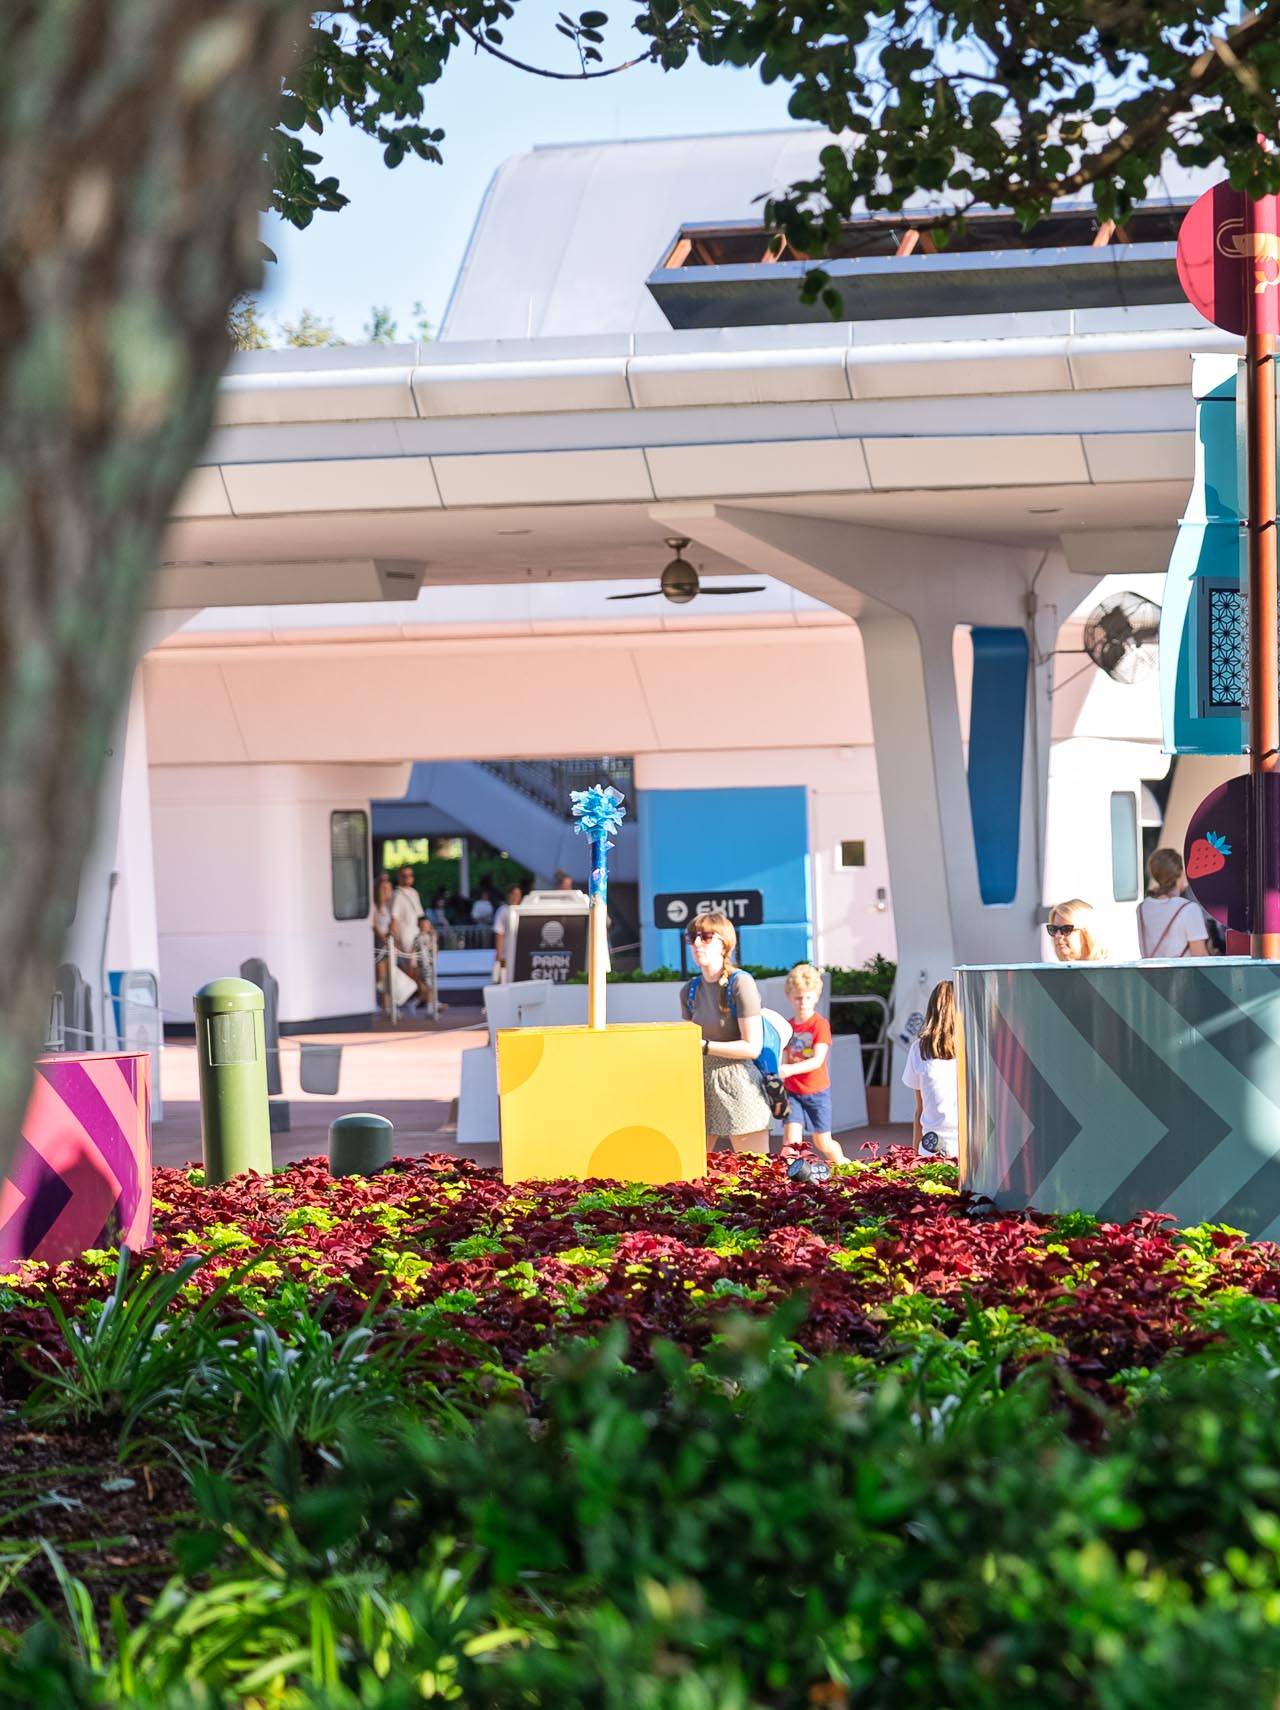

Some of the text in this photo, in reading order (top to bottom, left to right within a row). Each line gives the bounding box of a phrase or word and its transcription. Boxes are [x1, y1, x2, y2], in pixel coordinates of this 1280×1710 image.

[696, 899, 749, 918] EXIT
[532, 955, 571, 969] PARK
[531, 968, 570, 981] EXIT
